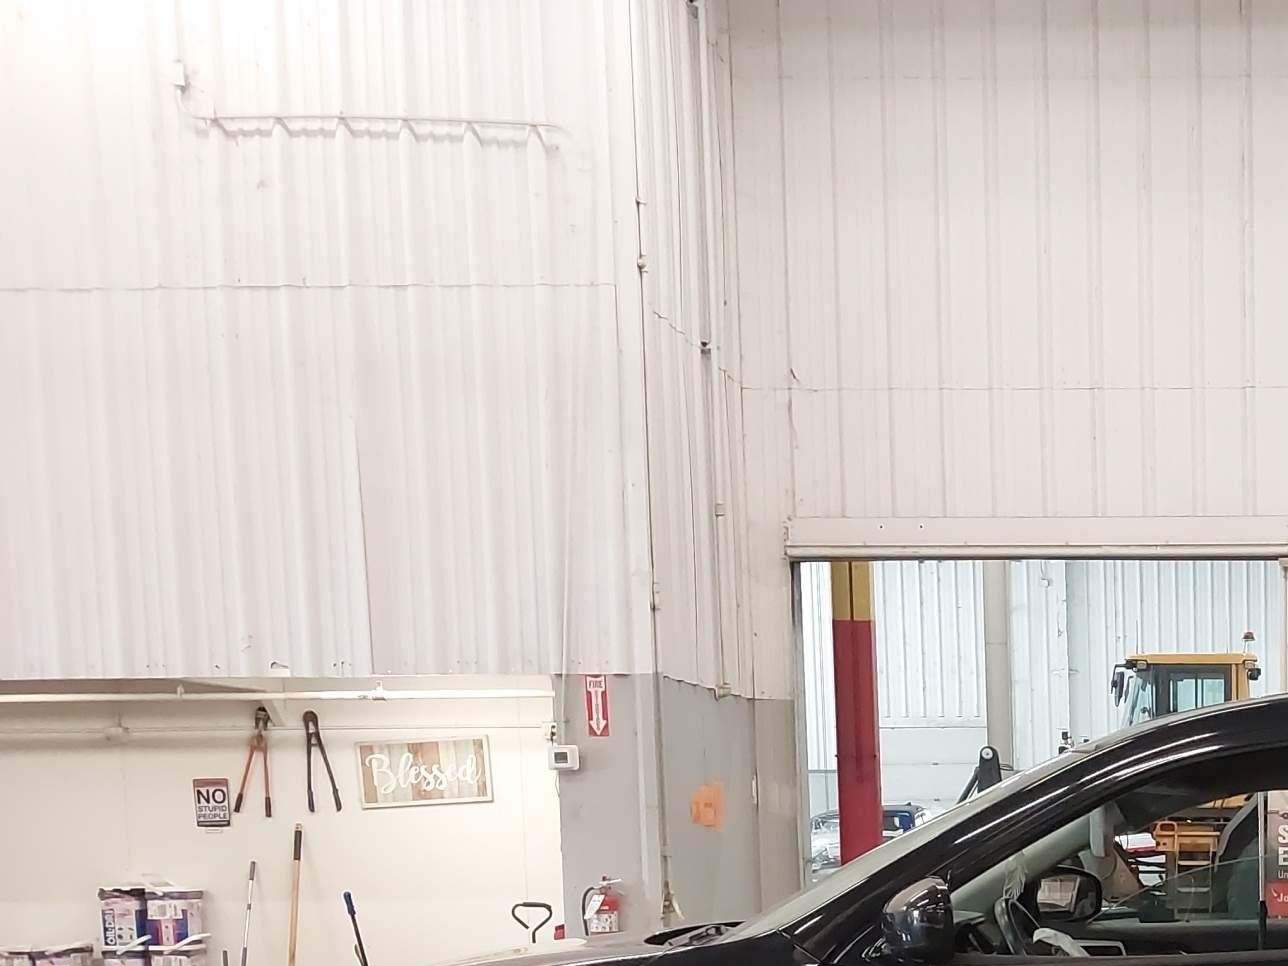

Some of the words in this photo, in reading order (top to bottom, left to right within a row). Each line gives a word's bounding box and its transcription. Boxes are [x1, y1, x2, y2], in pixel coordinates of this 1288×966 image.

[589, 680, 603, 688] FIRE
[365, 752, 481, 794] Blessed
[196, 789, 227, 805] NO
